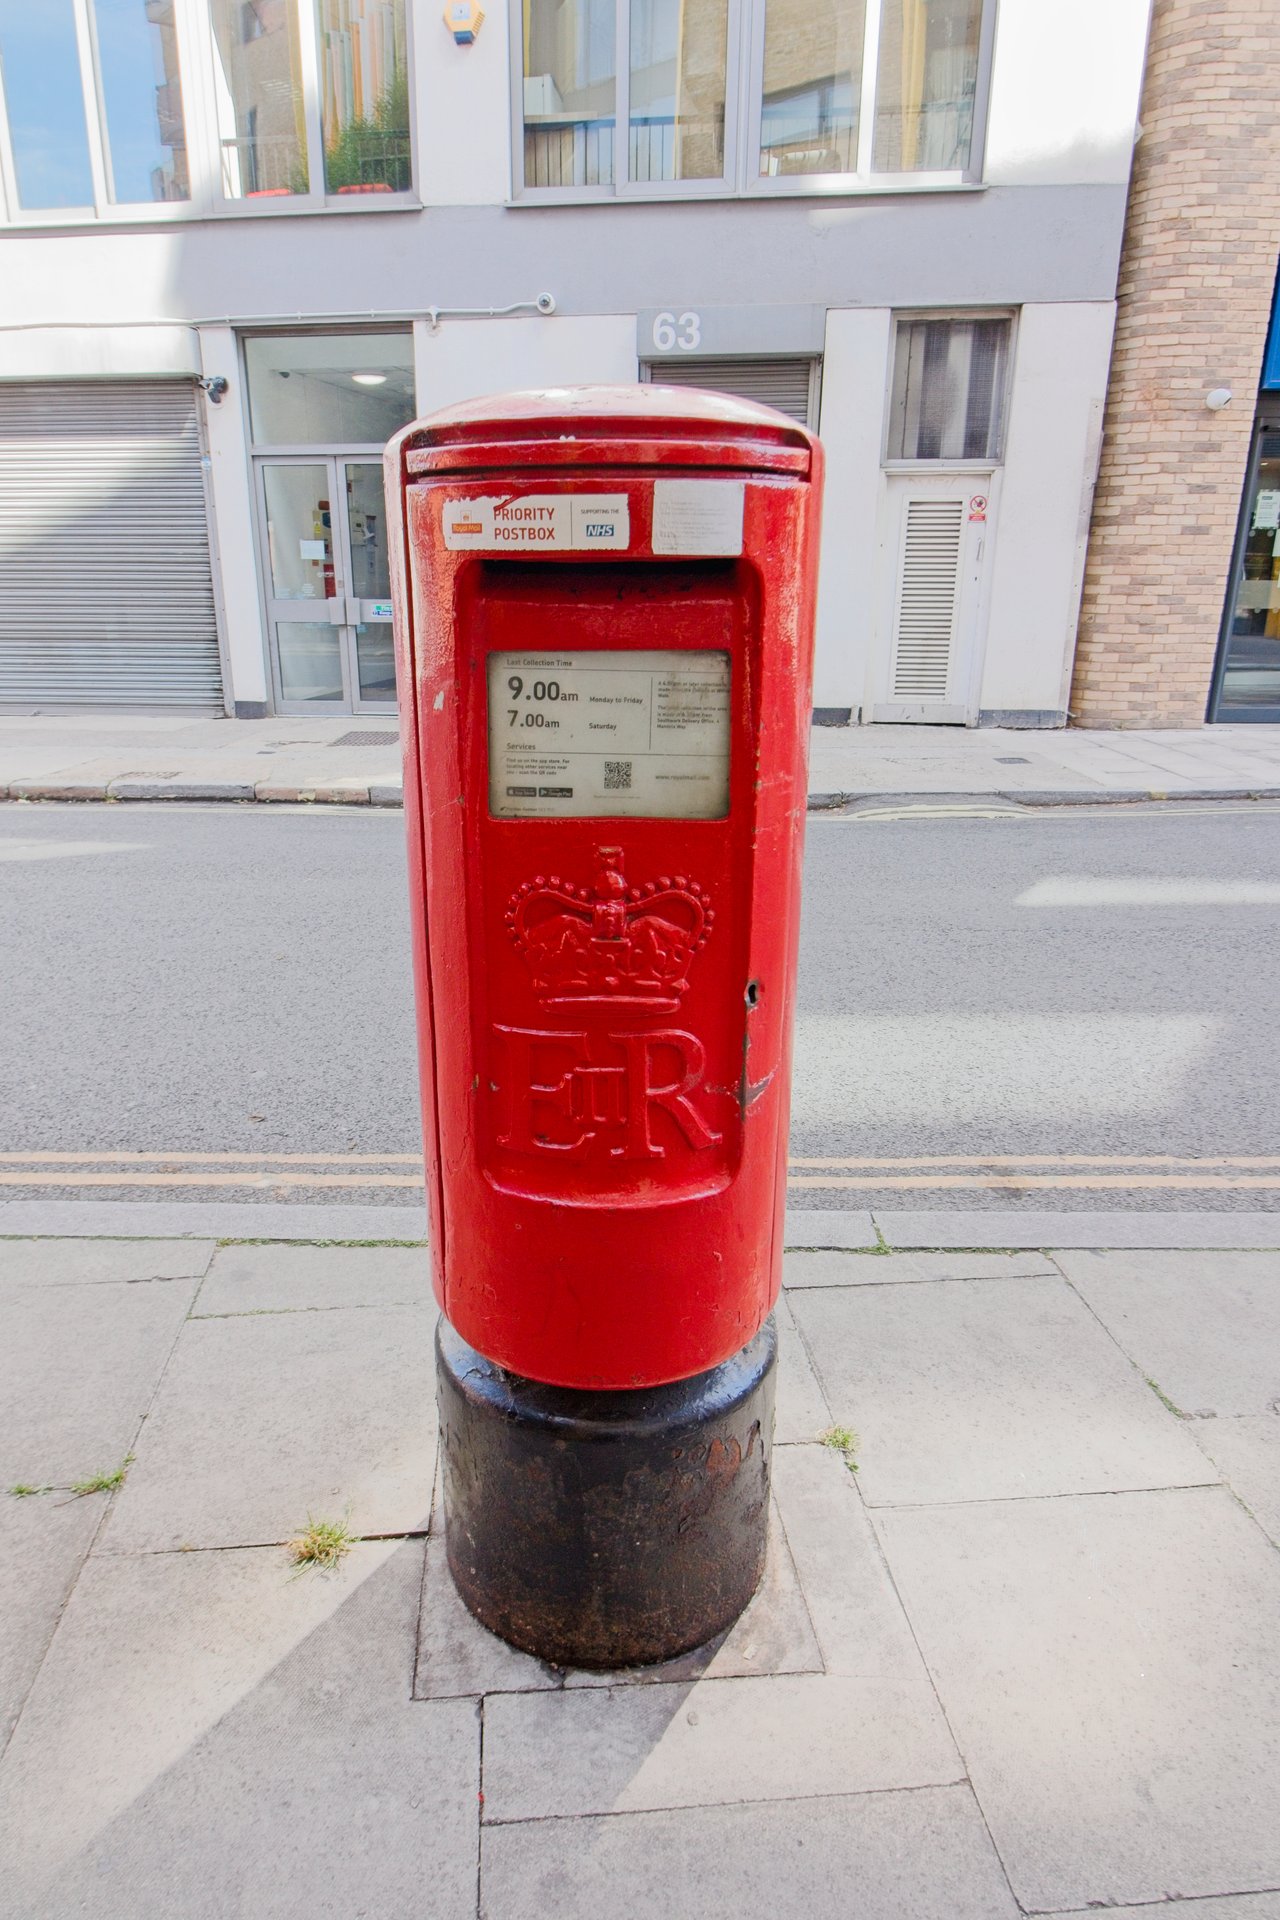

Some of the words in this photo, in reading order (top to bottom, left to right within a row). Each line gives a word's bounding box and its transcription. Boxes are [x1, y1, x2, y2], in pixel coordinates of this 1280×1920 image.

[652, 312, 701, 351] 63
[494, 508, 554, 521] PRIORITY
[494, 527, 555, 540] POSTBOX
[587, 525, 613, 536] NHS
[508, 676, 578, 701] 9.00am
[507, 710, 560, 728] 7.00am
